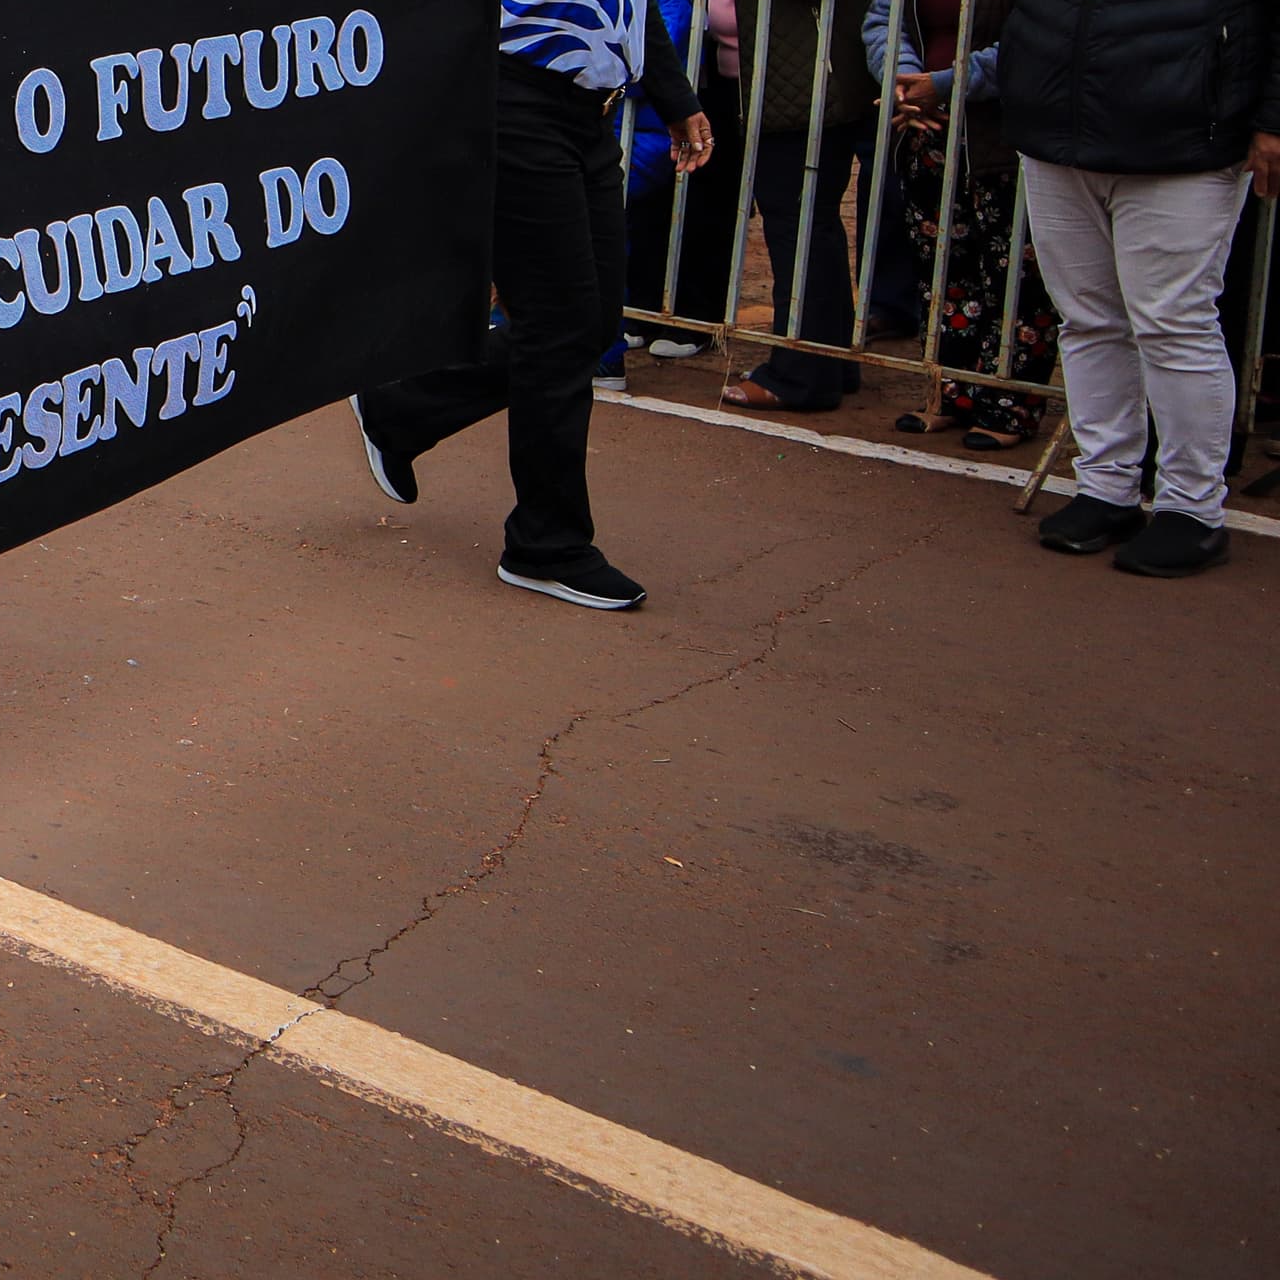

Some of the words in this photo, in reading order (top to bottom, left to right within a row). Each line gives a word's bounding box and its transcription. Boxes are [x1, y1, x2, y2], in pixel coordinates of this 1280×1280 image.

[15, 68, 65, 153] O
[90, 9, 383, 141] FUTURO
[259, 157, 350, 248] DO
